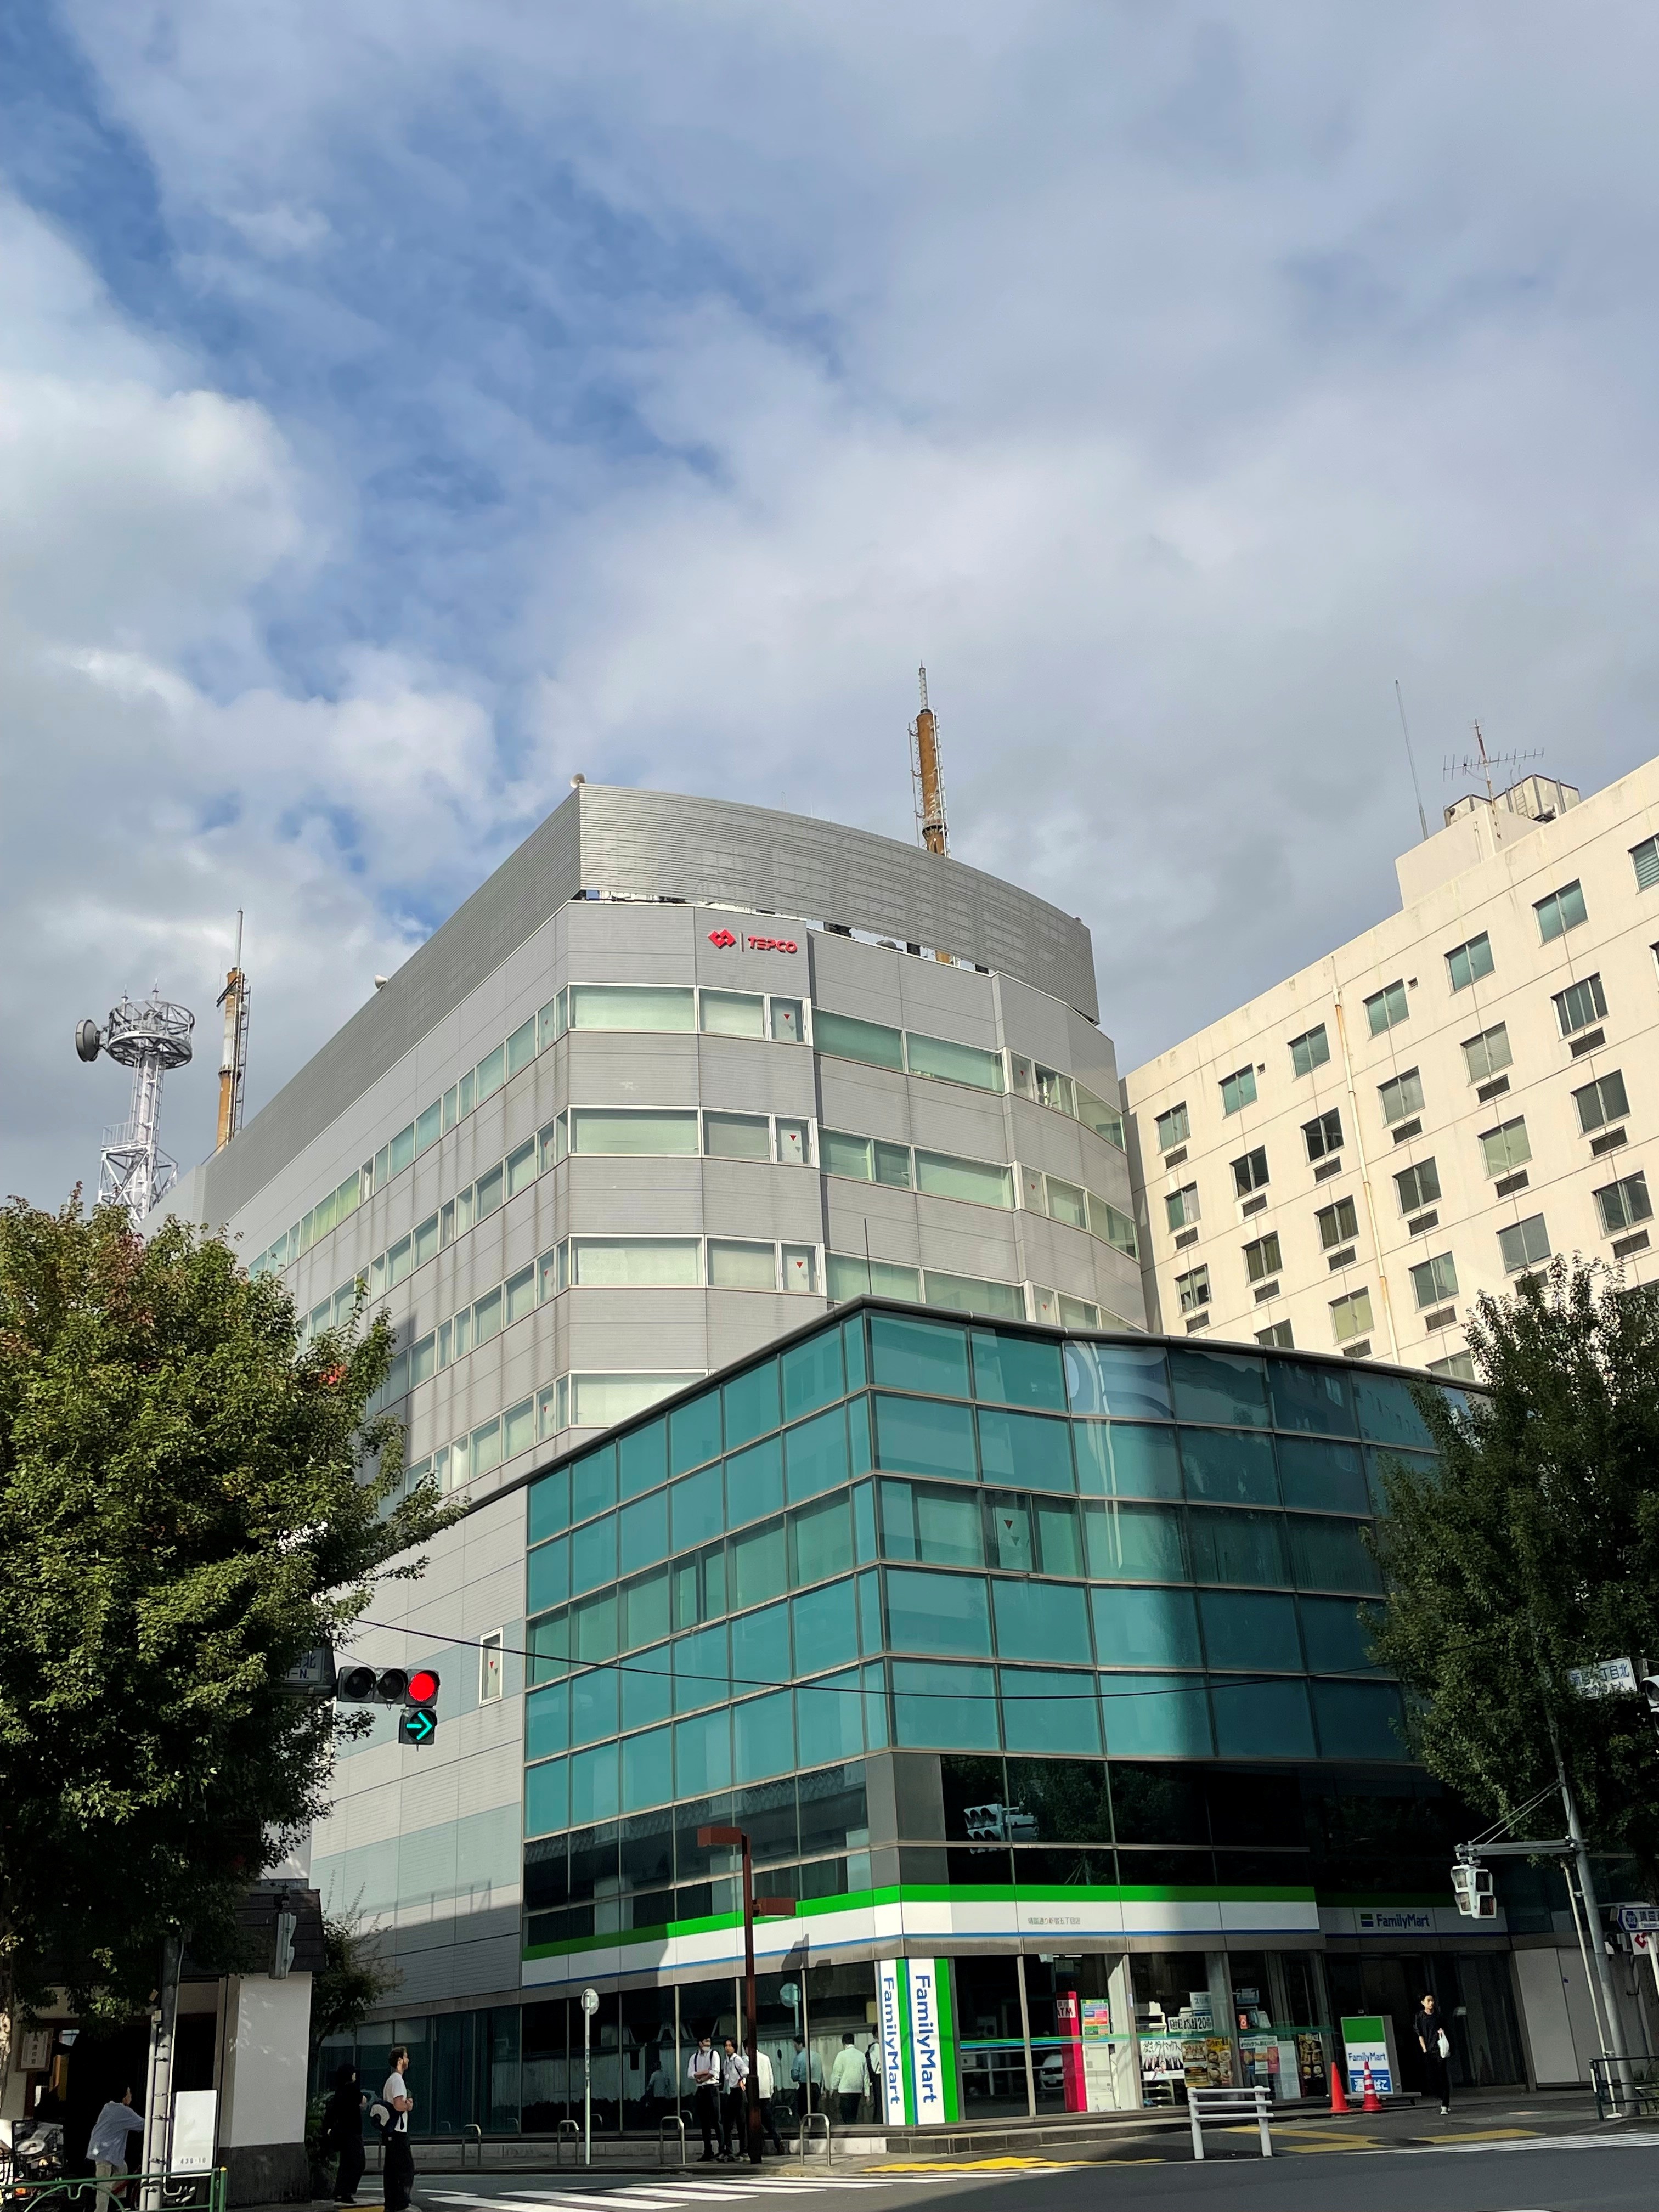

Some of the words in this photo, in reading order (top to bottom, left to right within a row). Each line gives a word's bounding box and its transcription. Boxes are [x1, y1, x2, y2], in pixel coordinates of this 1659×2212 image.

[748, 935, 798, 954] TEPCO
[1376, 1914, 1430, 1929] FamilyMart
[883, 1977, 901, 2104] FamilyMart
[915, 1975, 938, 2103] FamilyMart
[1348, 2052, 1386, 2062] FamilyMart
[1354, 2078, 1389, 2092] 酒ばこ
